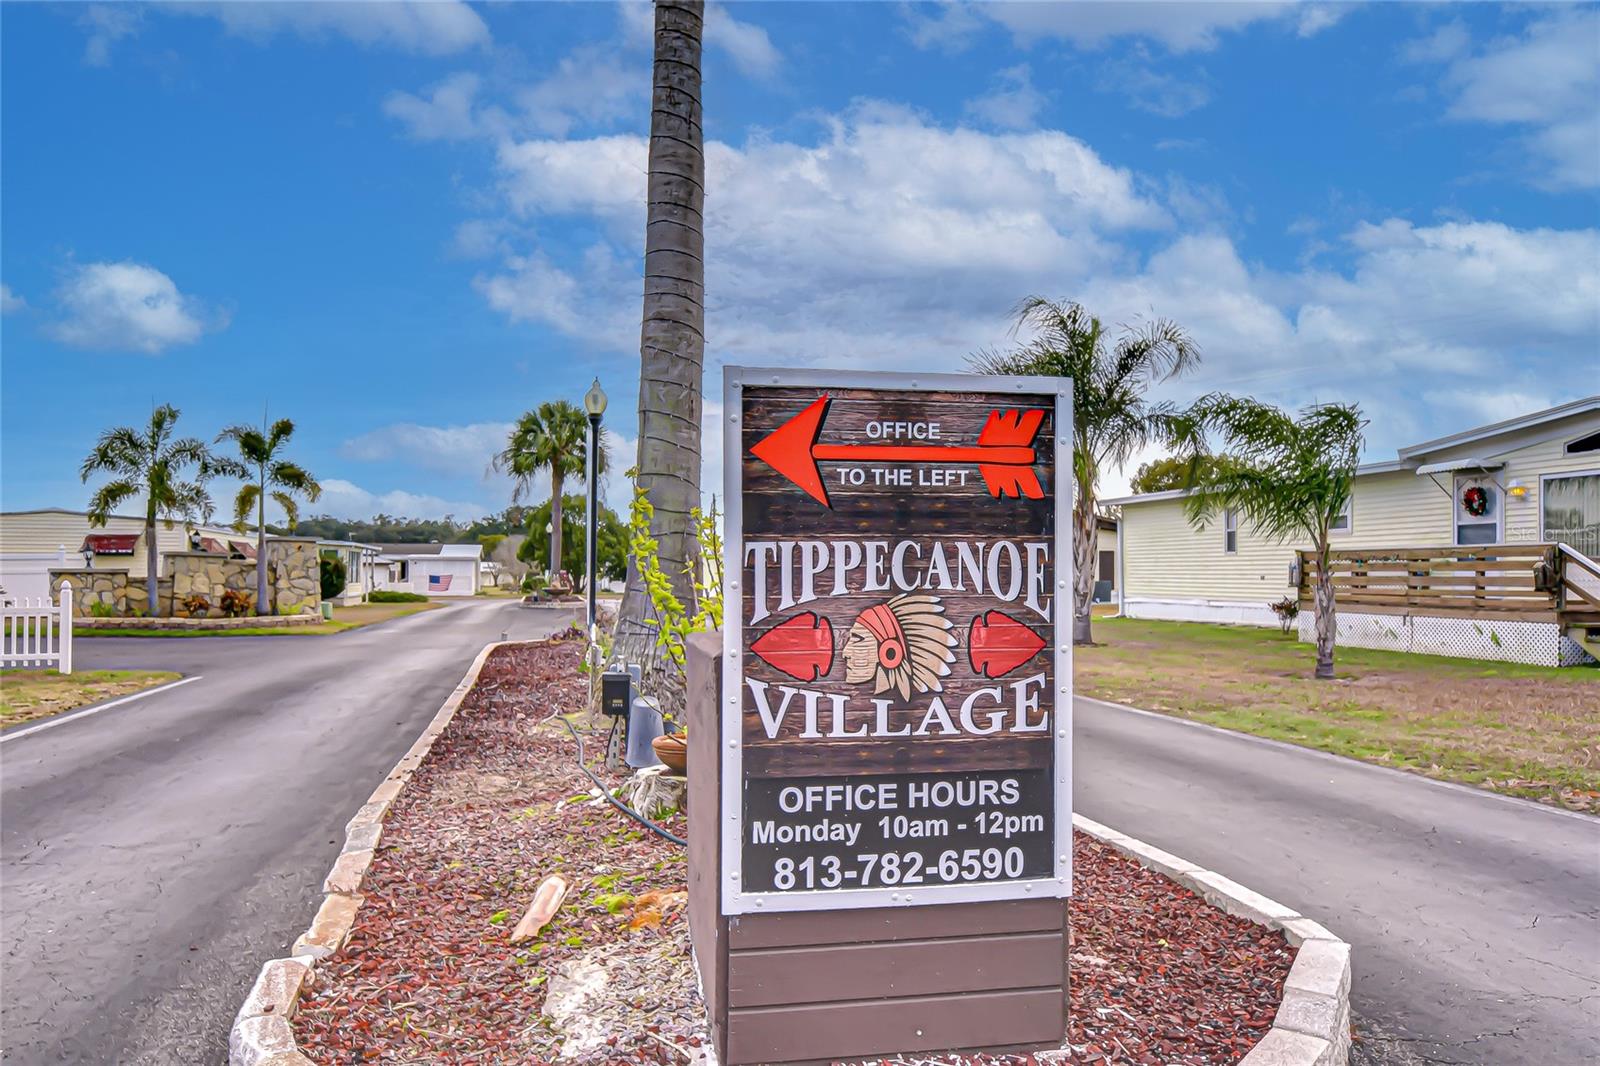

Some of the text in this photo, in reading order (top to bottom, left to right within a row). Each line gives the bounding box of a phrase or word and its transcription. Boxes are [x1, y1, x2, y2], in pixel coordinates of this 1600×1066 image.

[866, 421, 940, 440] OFFICE
[837, 468, 969, 486] TO THE LEFT
[744, 540, 1050, 625] TIPPECANOE
[745, 672, 1049, 739] VILLAGE
[779, 779, 1020, 813] OFFICE HOURS
[752, 819, 861, 846] Monday
[878, 816, 949, 839] 10am
[974, 812, 1044, 838] 12pm
[774, 847, 1024, 890] 813-782-6590
